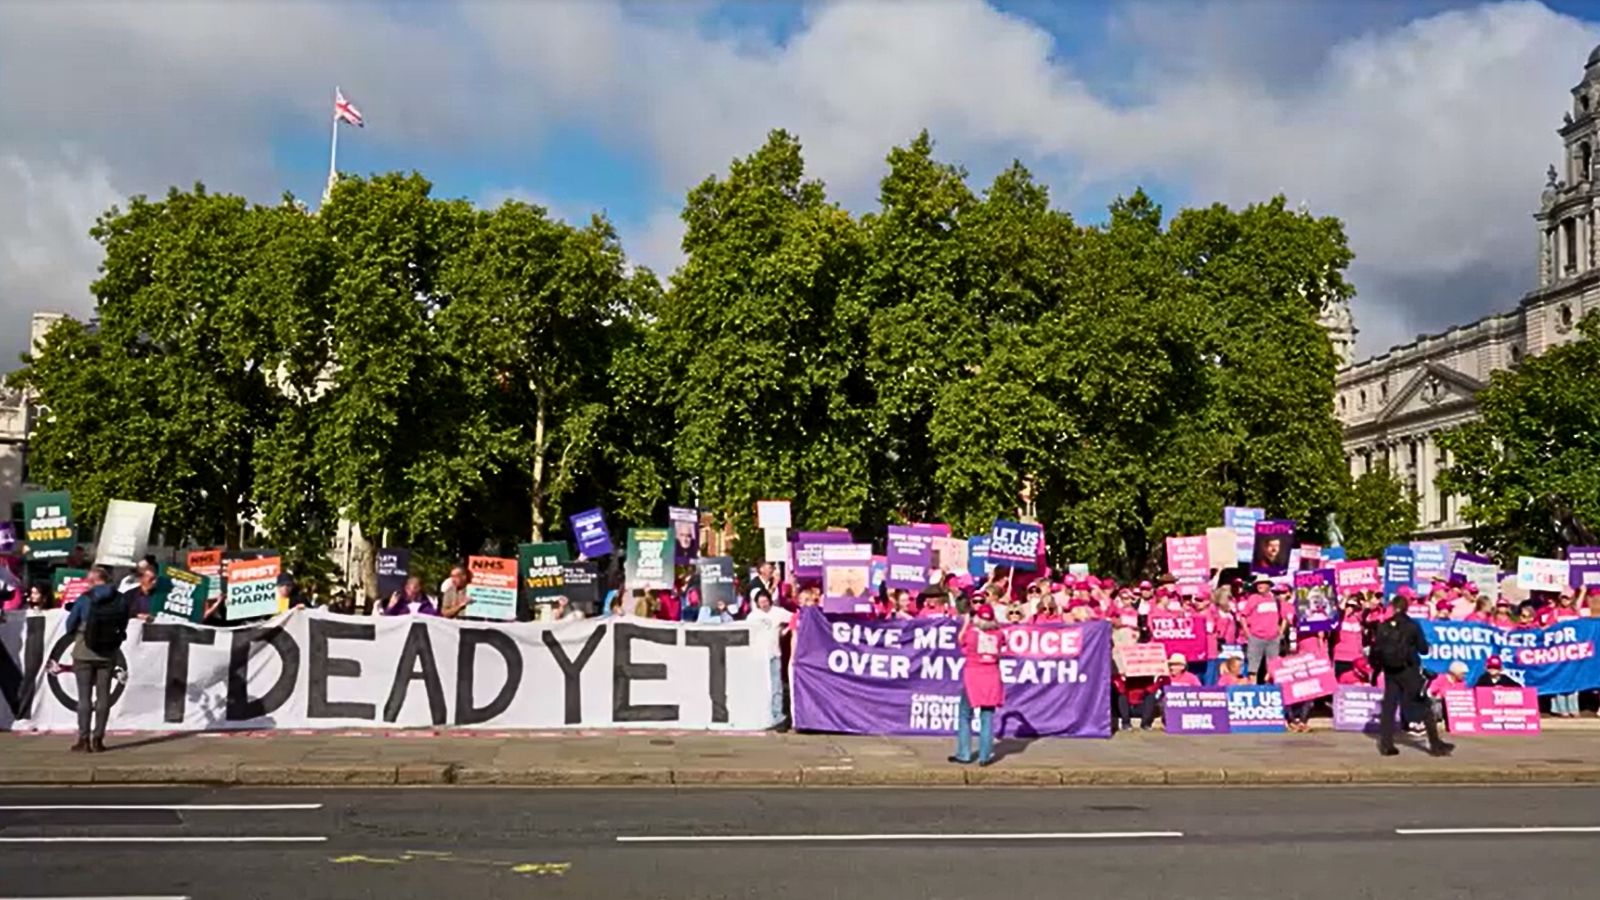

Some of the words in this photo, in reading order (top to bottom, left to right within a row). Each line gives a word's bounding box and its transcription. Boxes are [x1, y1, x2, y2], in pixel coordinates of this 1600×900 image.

[993, 527, 1018, 543] LET
[1020, 530, 1039, 547] US
[991, 541, 1037, 558] CHOOSE
[231, 585, 252, 596] DO
[255, 583, 275, 592] NO
[231, 593, 276, 606] HARM
[1152, 618, 1175, 631] YES
[832, 621, 902, 650] GIVE
[913, 626, 957, 650] ME
[1001, 629, 1080, 656] OICE
[1152, 629, 1197, 640] CHOICE.
[1434, 626, 1537, 648] TOGETHER
[1543, 627, 1577, 647] FOR
[1500, 648, 1514, 664] &
[1519, 642, 1593, 665] CHOICE.
[225, 617, 523, 726] DEAD
[541, 623, 750, 725] YET
[828, 649, 910, 680] OVER
[919, 655, 967, 681] MY
[999, 658, 1089, 685] EATH.
[1259, 691, 1283, 706] US
[910, 714, 928, 730] IN
